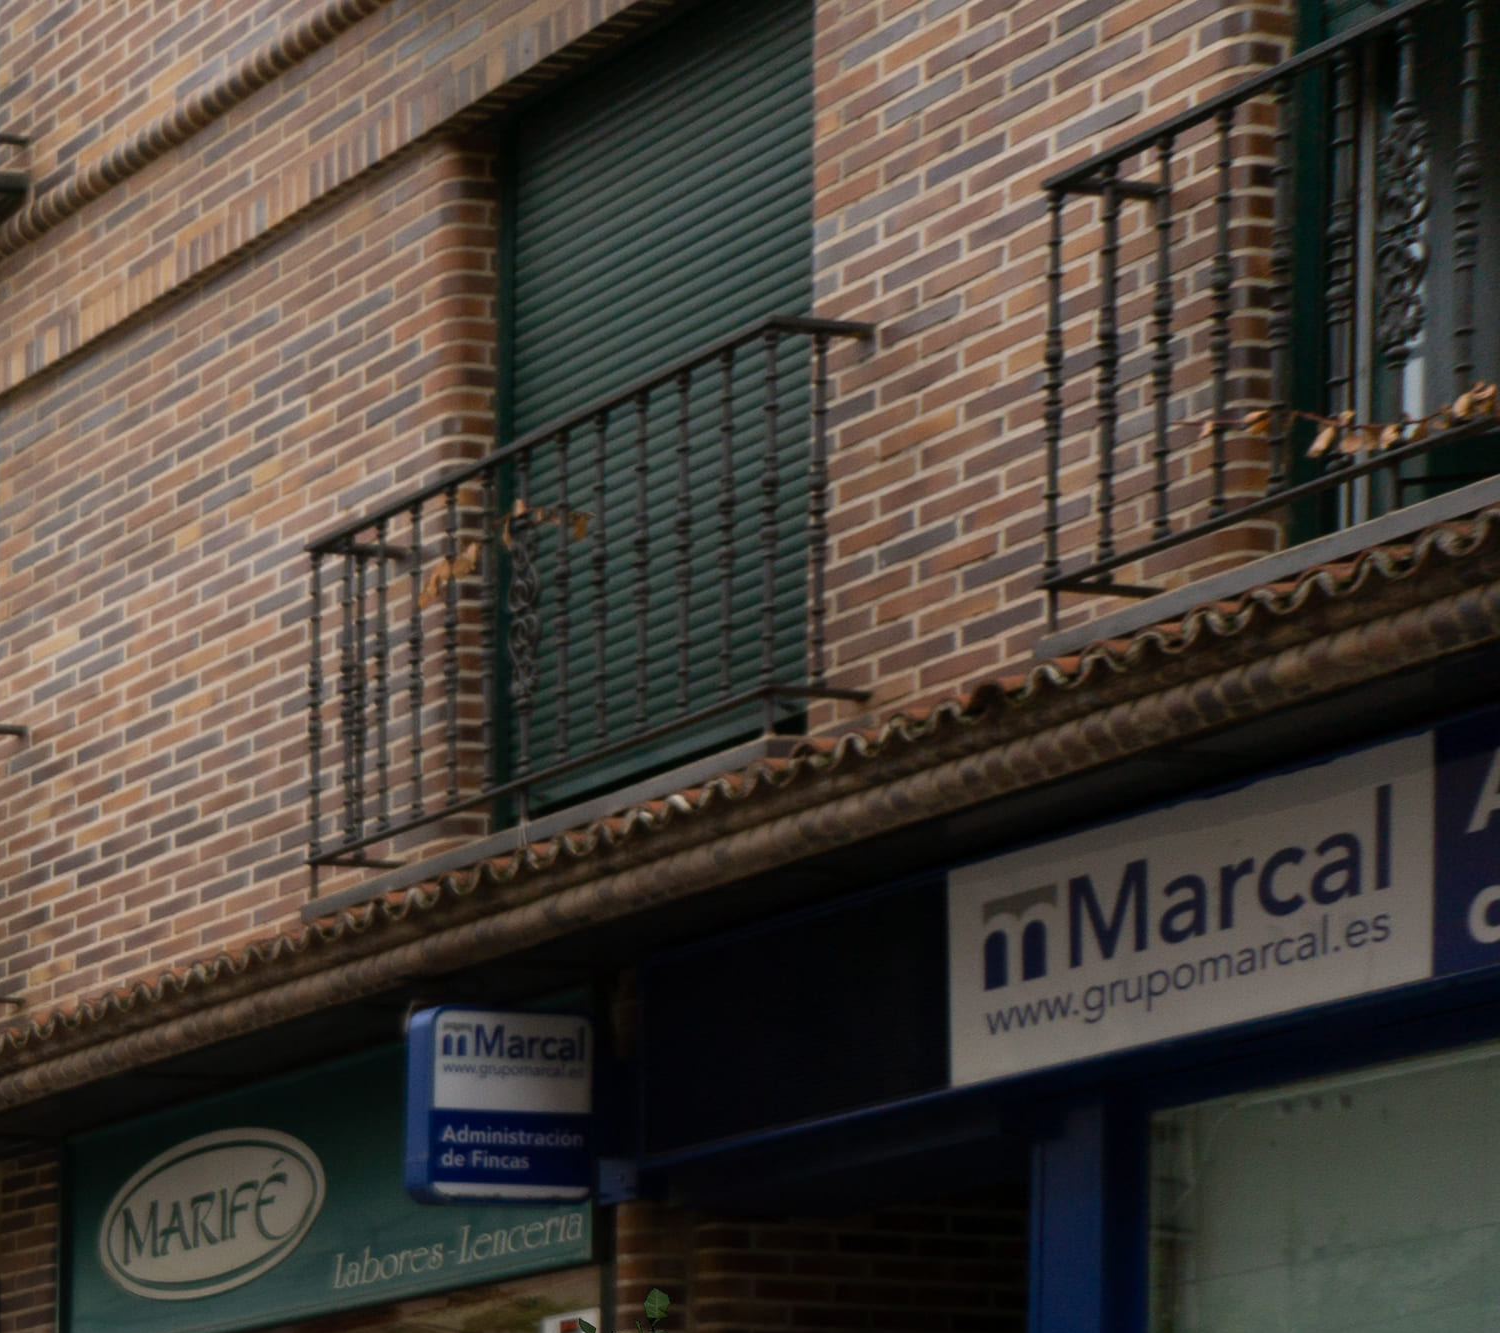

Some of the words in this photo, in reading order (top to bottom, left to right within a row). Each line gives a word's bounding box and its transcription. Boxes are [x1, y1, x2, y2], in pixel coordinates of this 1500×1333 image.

[1067, 784, 1393, 969] Marcal
[985, 910, 1392, 1036] www.grupomarcal.es
[475, 1023, 586, 1062] Marcal
[441, 1124, 584, 1147] Administración
[441, 1148, 465, 1167] de
[471, 1150, 530, 1169] Fincas
[121, 1158, 289, 1266] MARIFÉ
